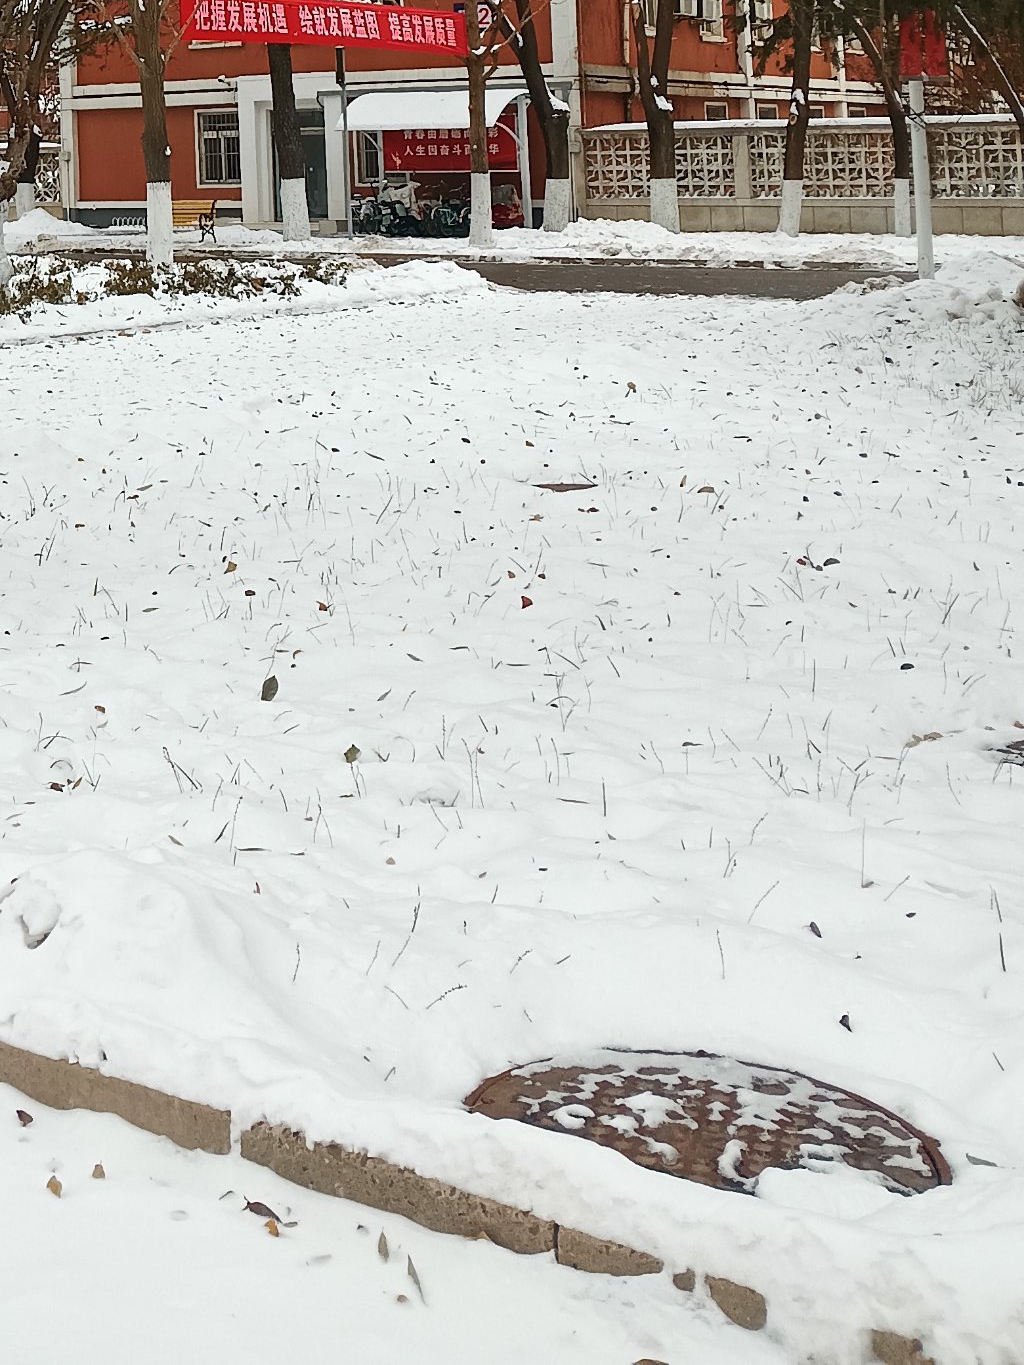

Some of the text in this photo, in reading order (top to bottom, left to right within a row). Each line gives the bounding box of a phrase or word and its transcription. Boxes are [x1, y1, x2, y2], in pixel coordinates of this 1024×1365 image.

[478, 8, 490, 25] 2
[298, 4, 381, 40] 绘就发展蓝图
[388, 11, 457, 47] 提高发展质量
[403, 143, 500, 156] 人生因奋斗而华
